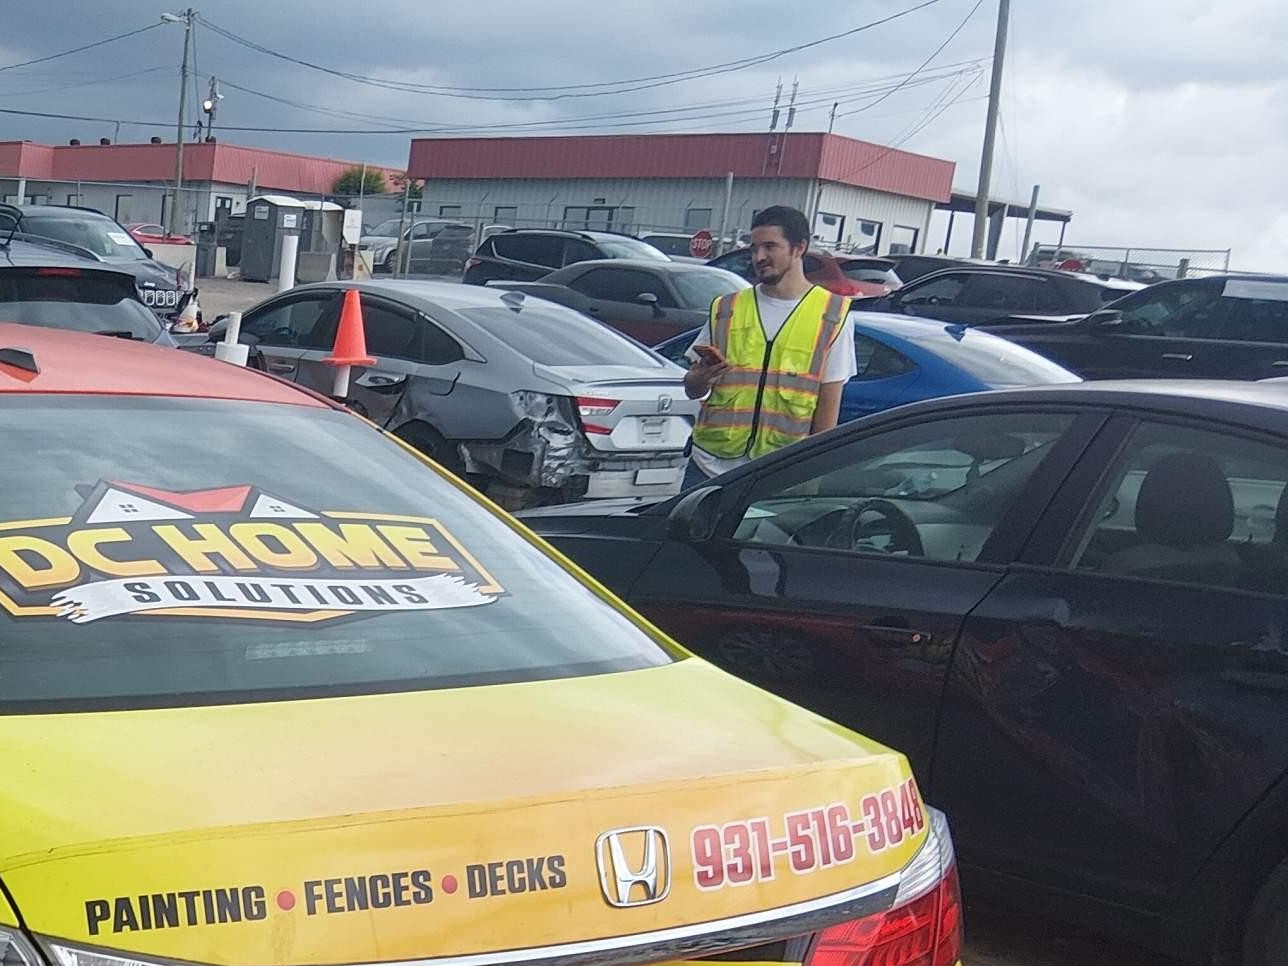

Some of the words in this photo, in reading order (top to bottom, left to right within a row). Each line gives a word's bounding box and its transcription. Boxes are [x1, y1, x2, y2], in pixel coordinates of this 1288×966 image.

[691, 238, 713, 250] STOP
[151, 522, 461, 573] HOME
[123, 580, 430, 605] SOLUTIONS
[691, 776, 926, 889] 931-516-3848
[85, 885, 268, 936] PAINTING
[303, 869, 434, 916] FENCES
[465, 854, 567, 899] DECKS
